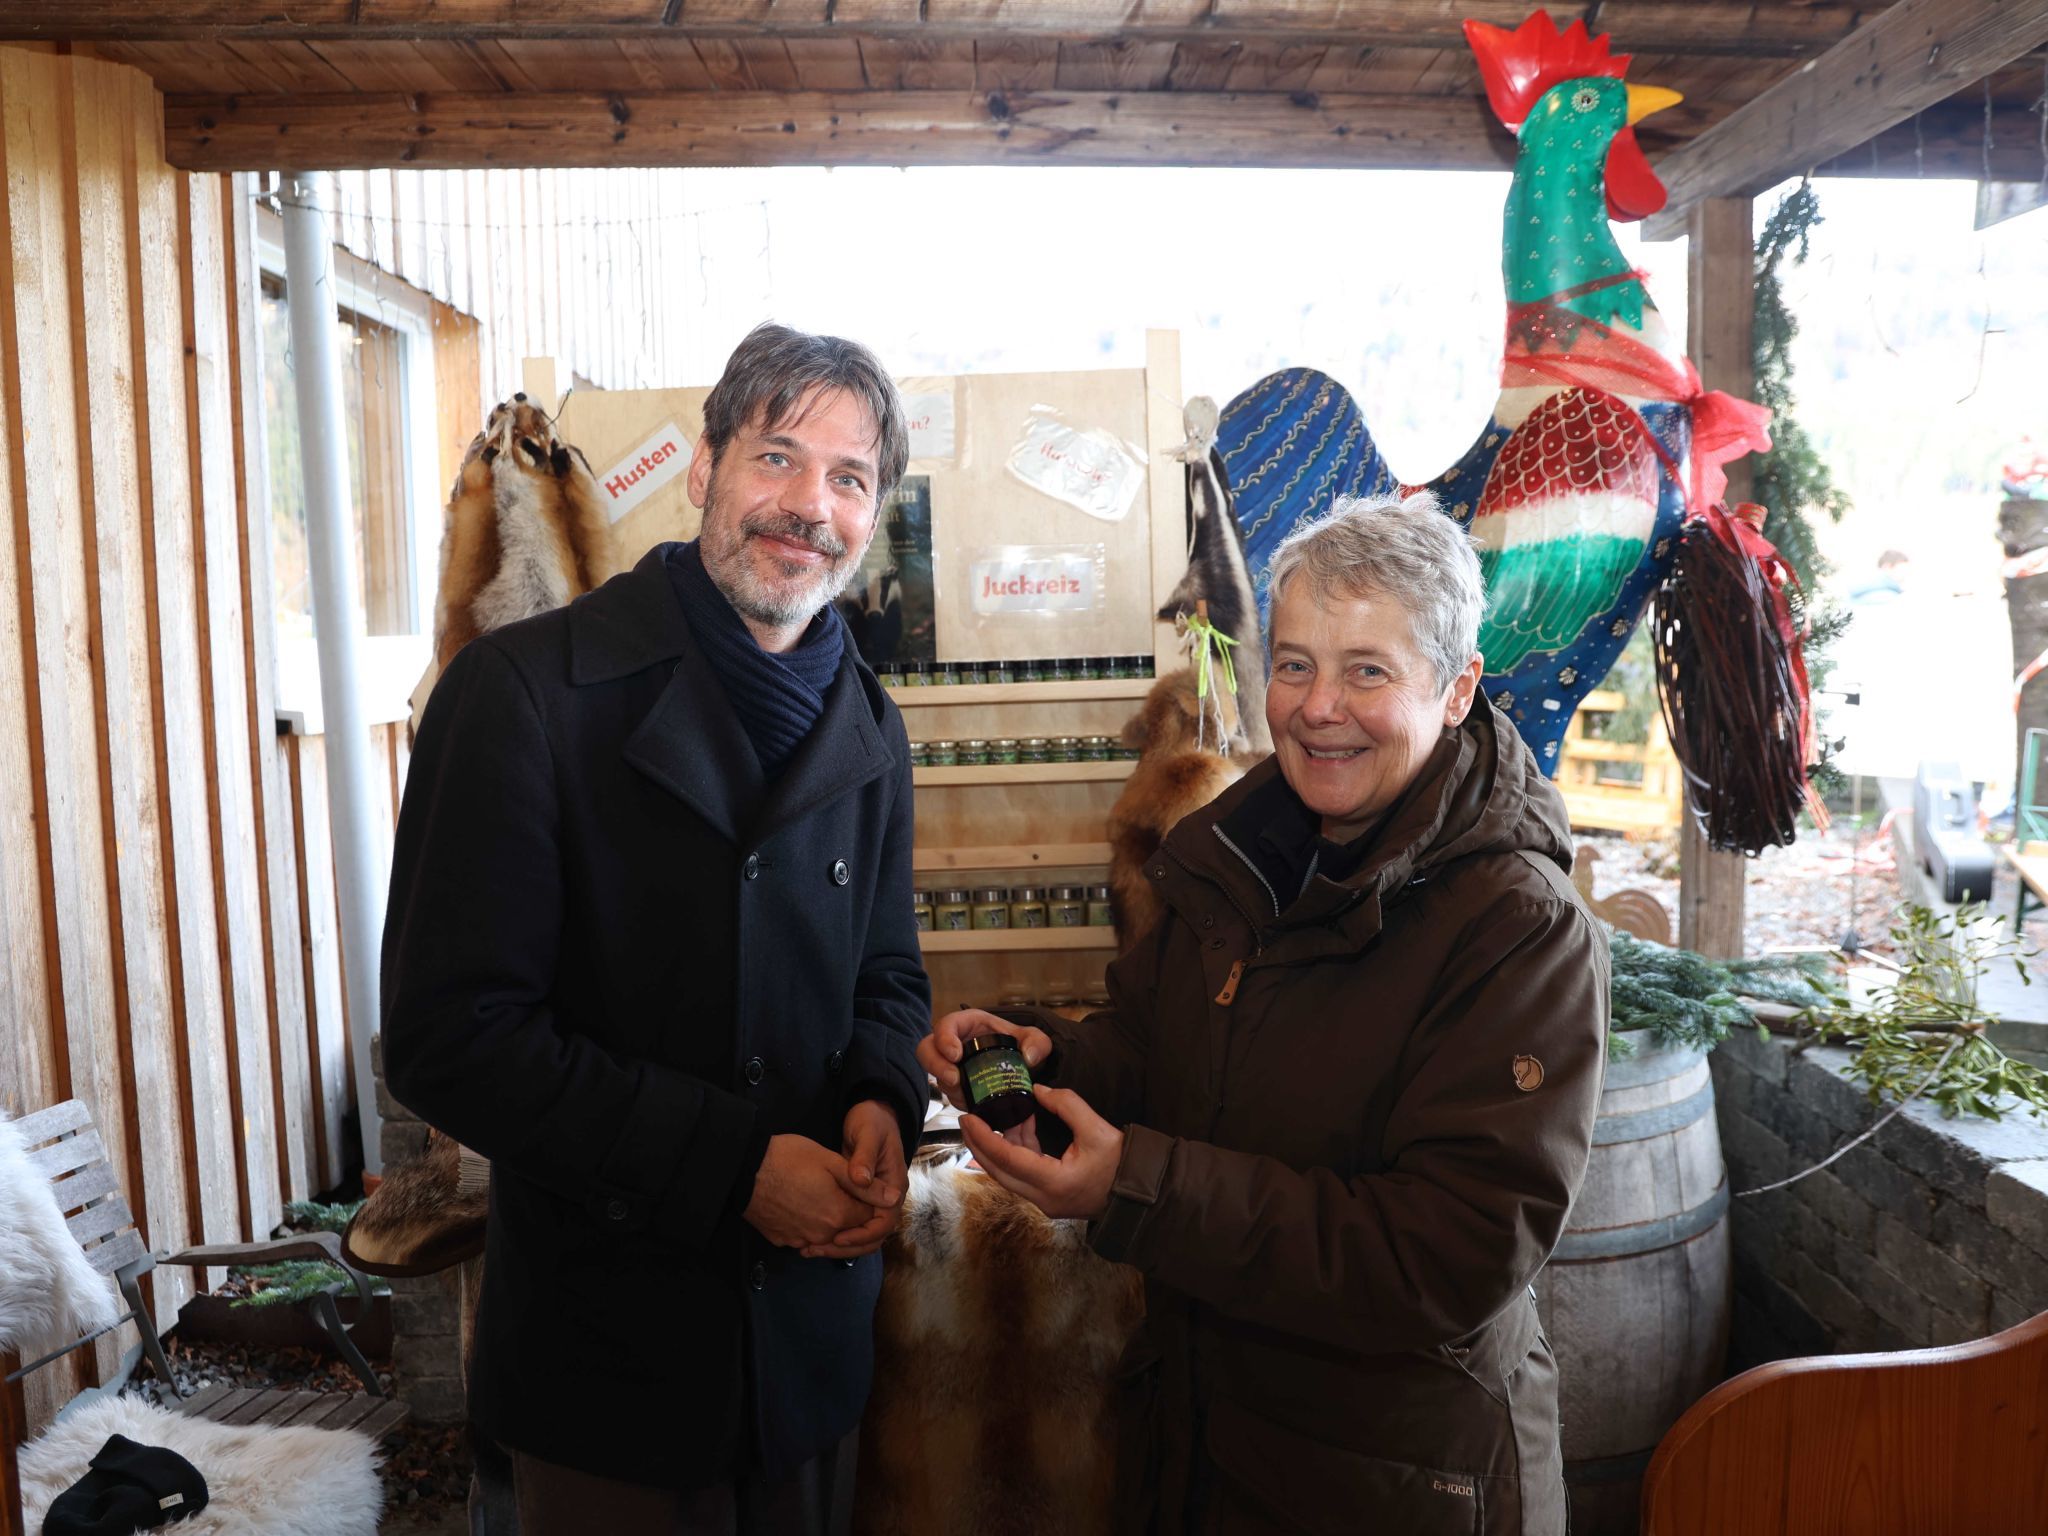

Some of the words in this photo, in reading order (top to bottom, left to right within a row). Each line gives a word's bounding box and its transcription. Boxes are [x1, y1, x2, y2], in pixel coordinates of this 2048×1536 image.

[604, 441, 678, 499] Husten
[982, 574, 1081, 598] Juckreiz
[1433, 1480, 1473, 1497] G-1000
